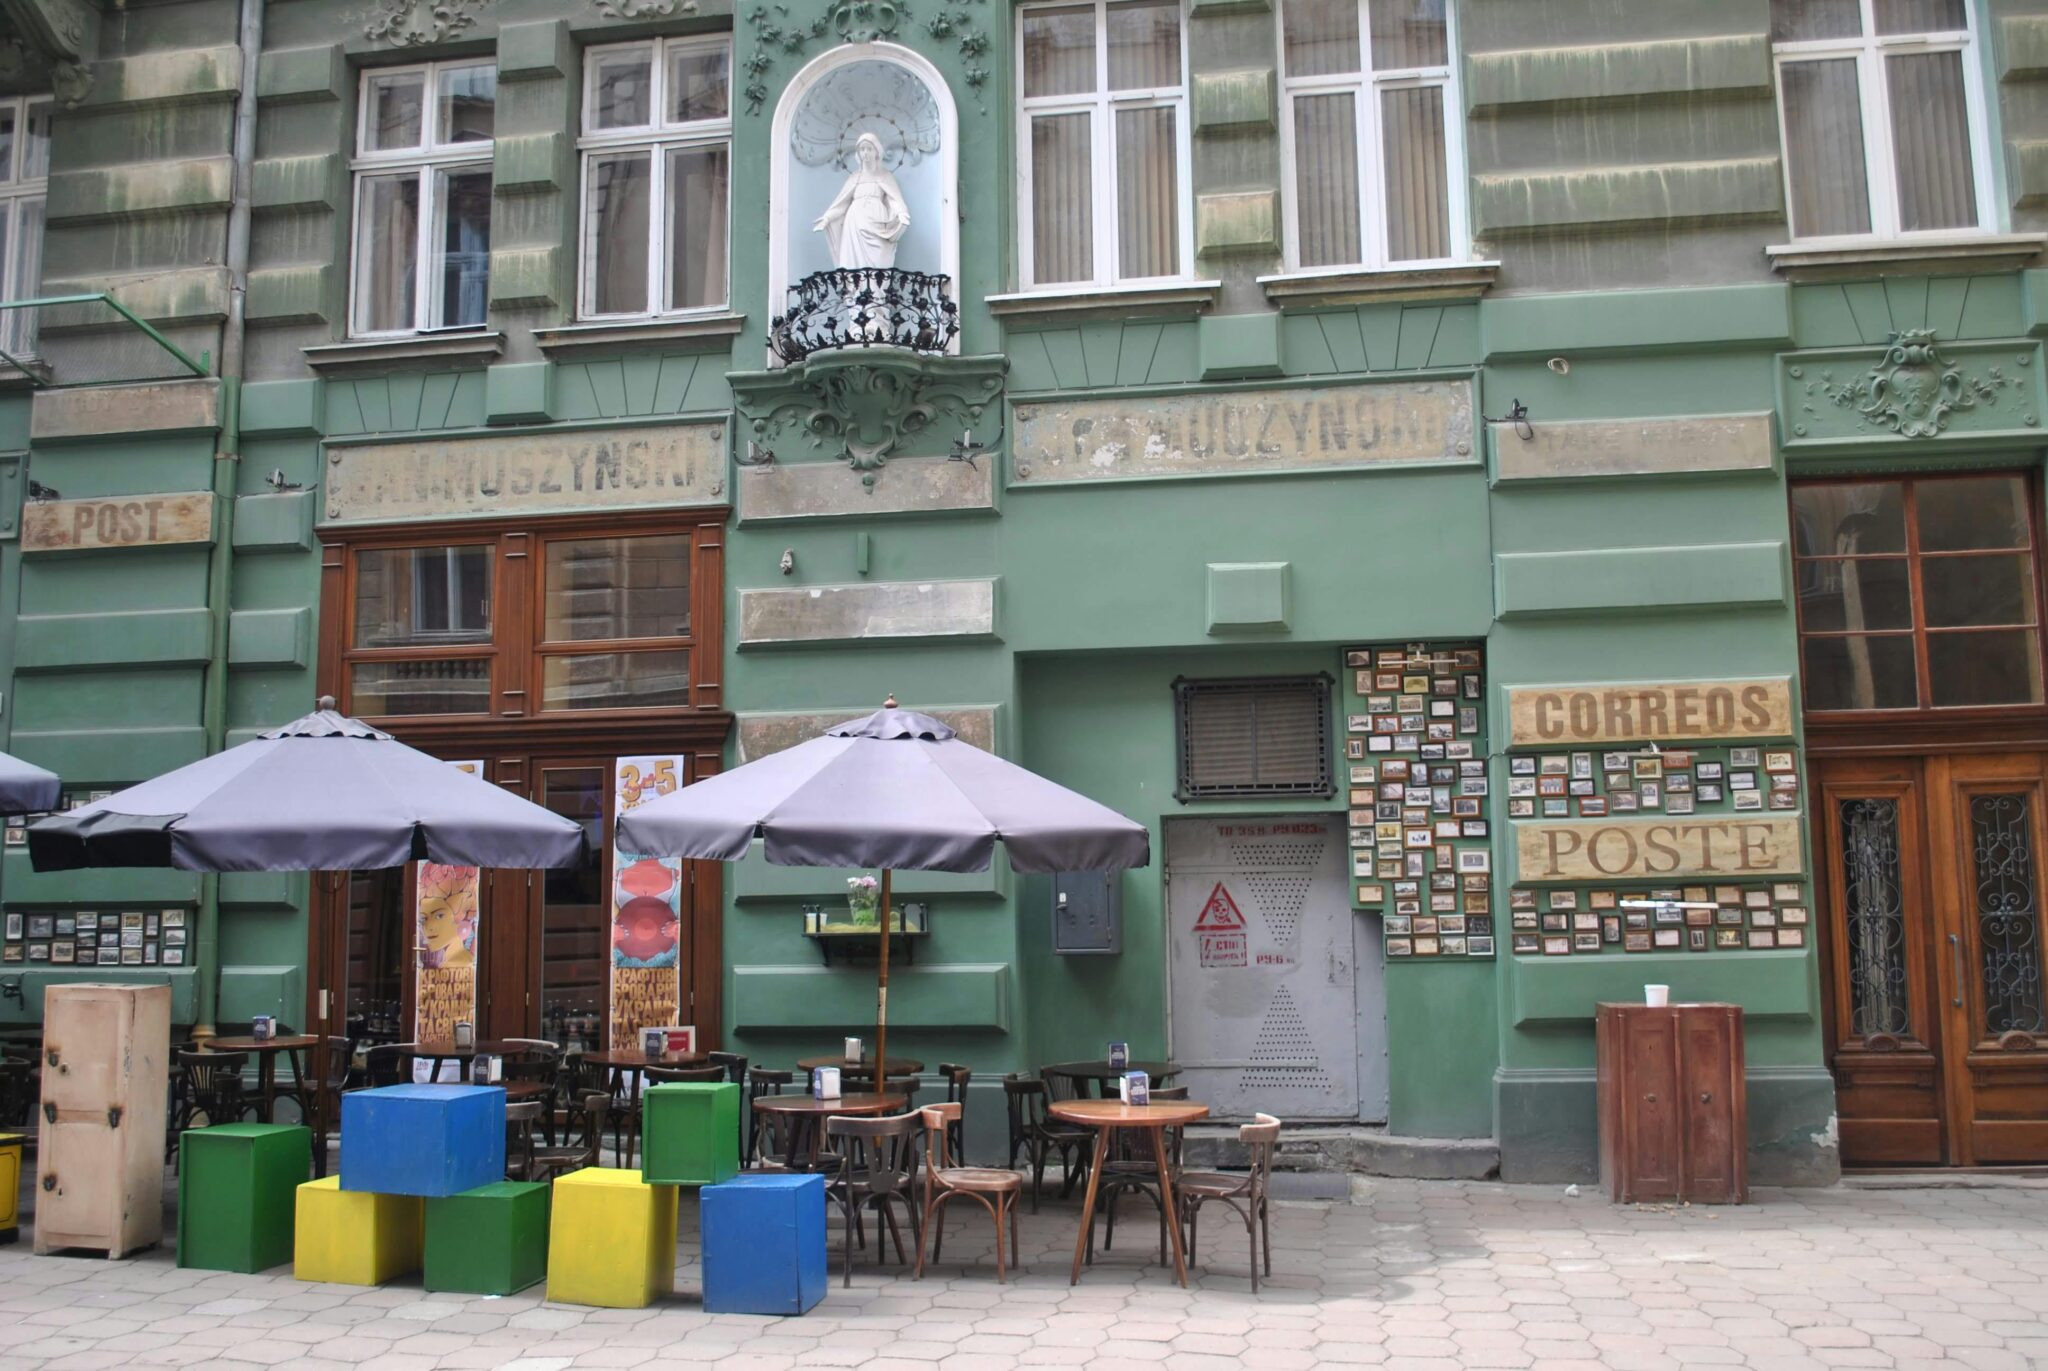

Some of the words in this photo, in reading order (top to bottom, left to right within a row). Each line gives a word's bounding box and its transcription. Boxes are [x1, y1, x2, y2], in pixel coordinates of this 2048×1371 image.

[73, 501, 163, 545] POST
[1535, 686, 1771, 739] CORREOS
[1541, 823, 1778, 875] POSTE
